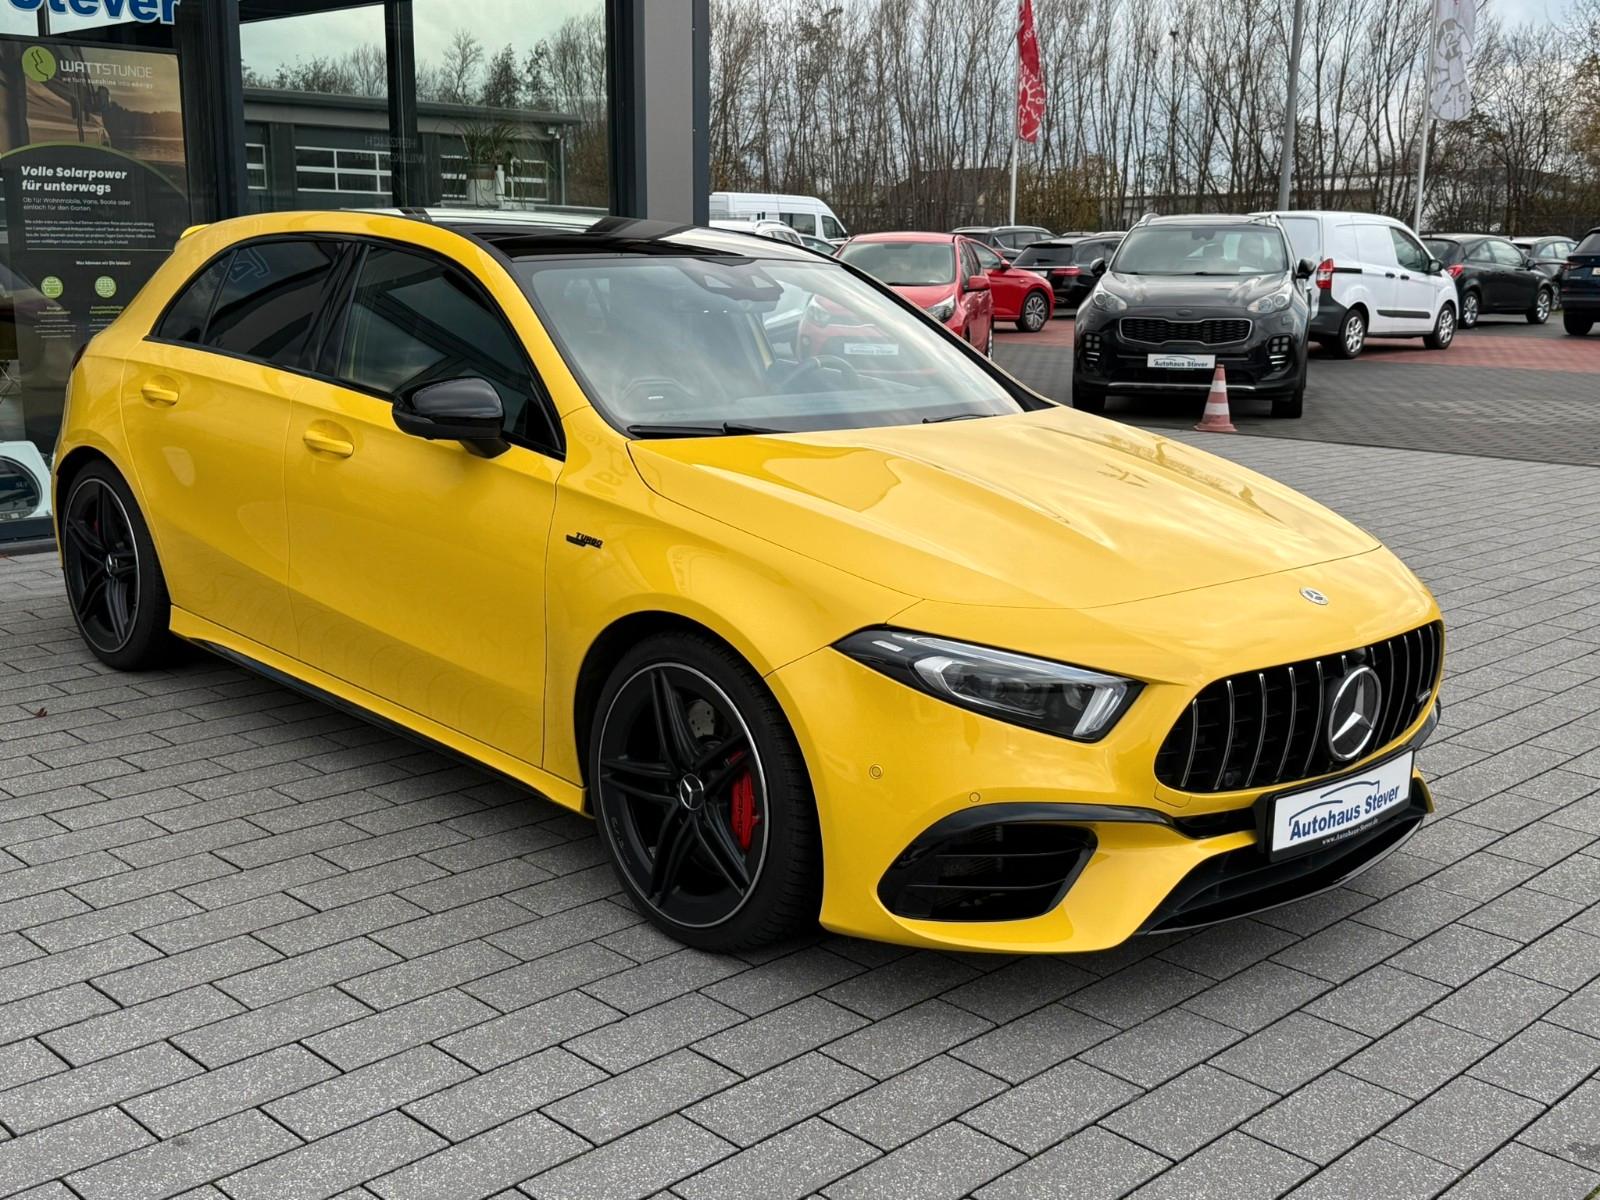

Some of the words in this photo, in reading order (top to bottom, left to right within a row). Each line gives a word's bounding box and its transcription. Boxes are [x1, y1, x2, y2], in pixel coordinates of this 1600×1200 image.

[10, 0, 180, 24] ever
[60, 60, 153, 79] WATTSTUNDE
[21, 166, 54, 177] Volle
[56, 167, 127, 181] Solarpower
[22, 180, 42, 191] für
[44, 182, 111, 195] unterwegs
[1154, 360, 1185, 368] Autohaus
[1290, 805, 1361, 841] Autohaus
[1364, 785, 1400, 815] Stever
